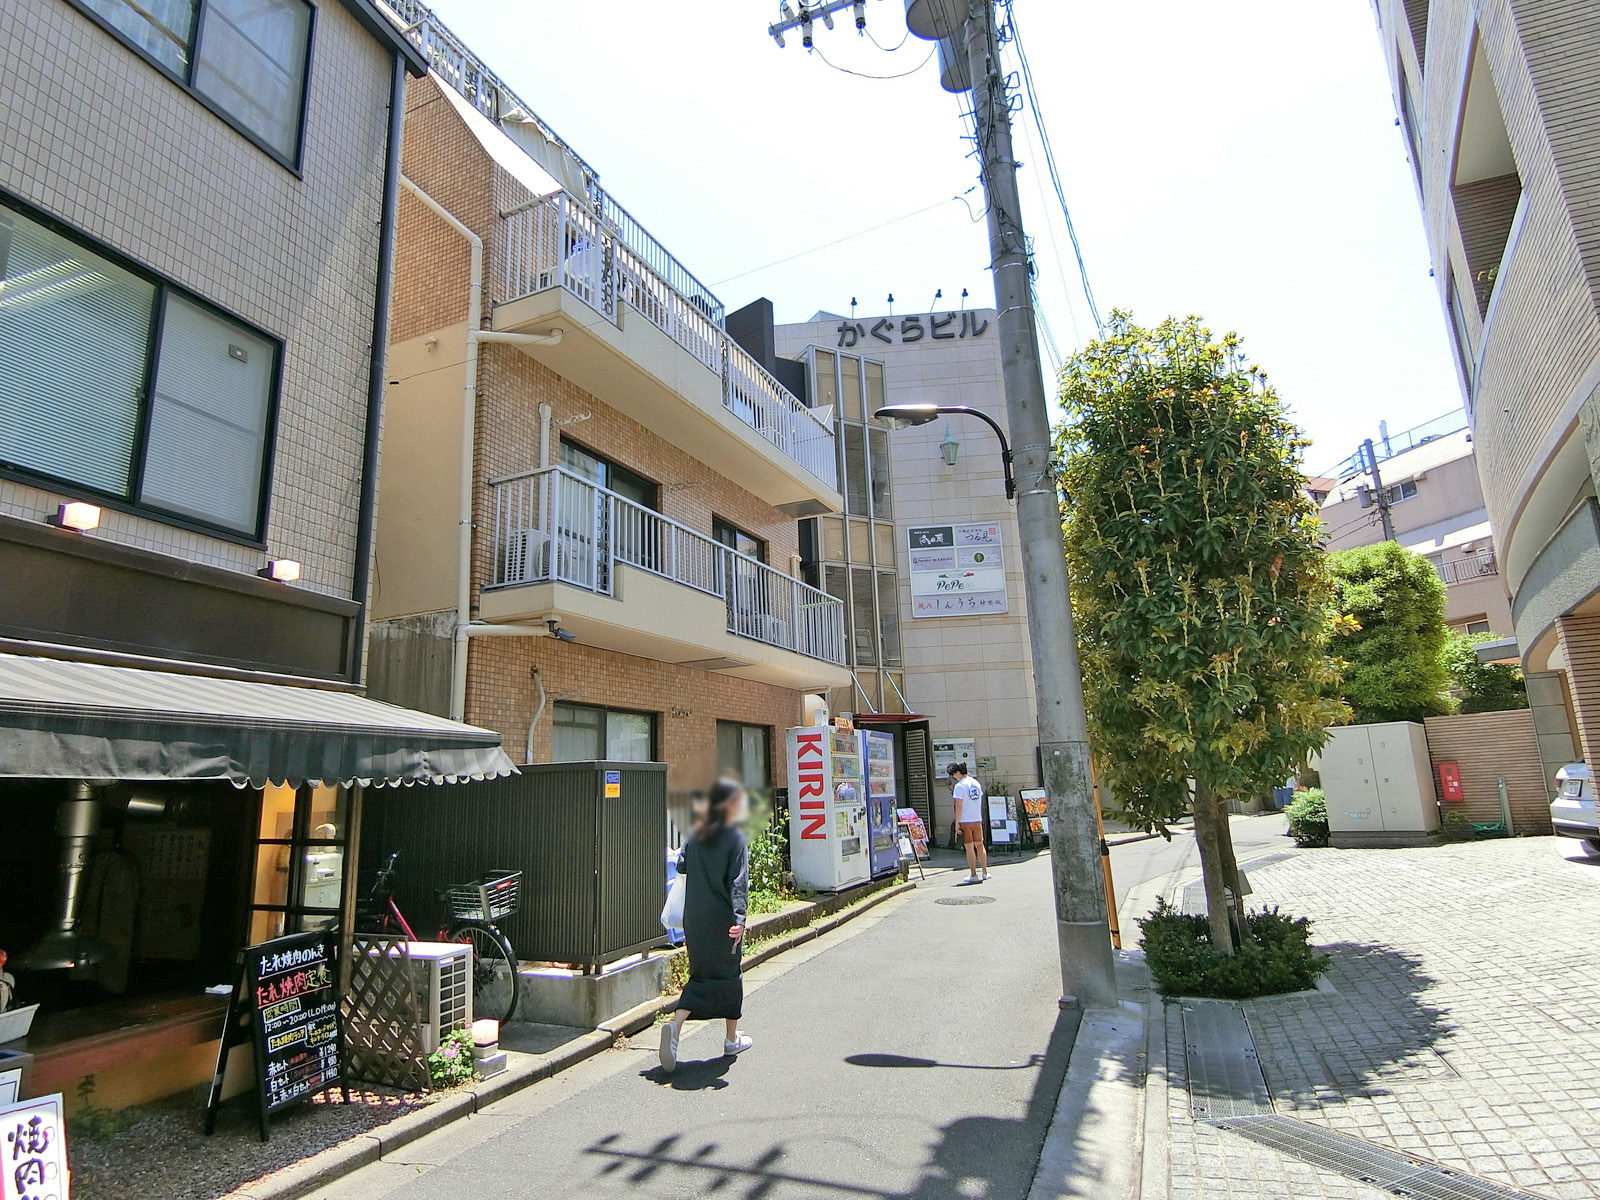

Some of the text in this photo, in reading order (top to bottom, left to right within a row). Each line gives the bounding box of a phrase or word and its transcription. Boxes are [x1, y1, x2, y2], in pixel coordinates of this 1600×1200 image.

[837, 311, 988, 347] かぐらビル
[937, 580, 964, 590] PePe
[797, 733, 827, 840] KIRIN
[260, 943, 325, 976] たれ焼肉のんき
[256, 964, 332, 1006] たれ焼肉定食
[7, 1114, 49, 1200] 焼肉
